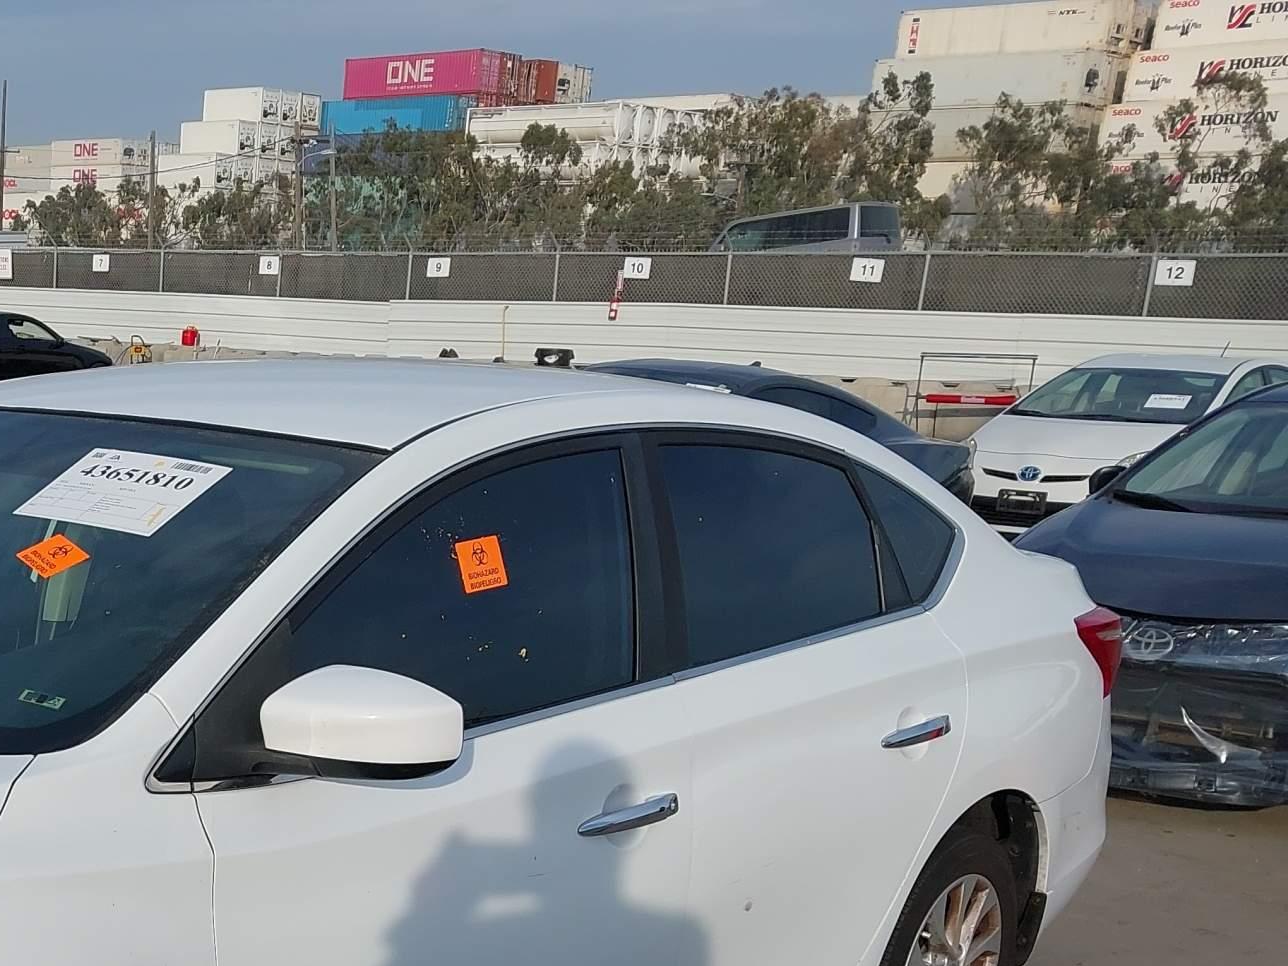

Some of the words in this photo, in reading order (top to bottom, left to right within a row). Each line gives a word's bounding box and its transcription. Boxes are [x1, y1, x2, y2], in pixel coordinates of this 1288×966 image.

[1170, 0, 1201, 9] seaco
[1139, 54, 1170, 64] seaco
[386, 58, 435, 84] ONE
[1112, 107, 1142, 117] seaco
[1200, 110, 1280, 127] HORIZON
[74, 143, 99, 157] ONE
[266, 260, 272, 270] 8
[435, 262, 442, 273] 9
[630, 262, 644, 273] 10
[860, 263, 876, 277] 11
[1165, 266, 1185, 280] 12
[79, 464, 196, 491] 43651810
